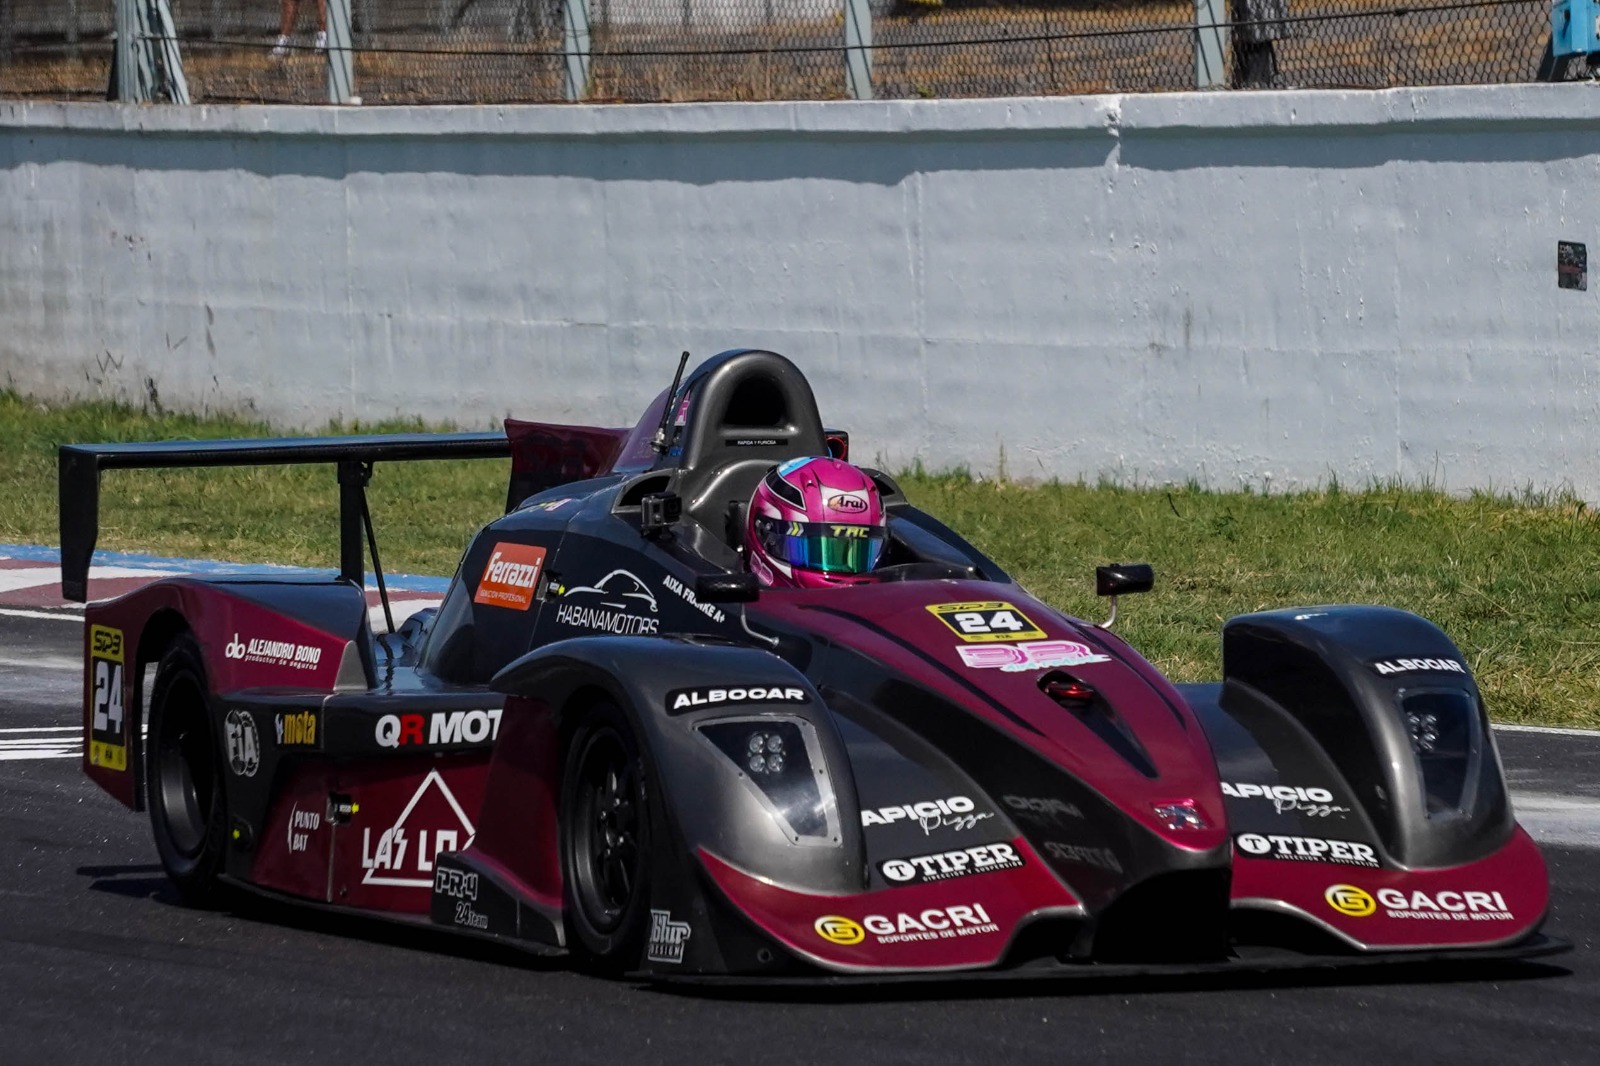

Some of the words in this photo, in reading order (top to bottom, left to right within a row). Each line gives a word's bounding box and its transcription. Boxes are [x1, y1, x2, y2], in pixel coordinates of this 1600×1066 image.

[837, 495, 864, 509] Arai
[484, 551, 542, 588] Ferrazzi
[662, 574, 684, 596] AIXA
[555, 603, 660, 634] HABANAMOTORS
[954, 610, 1023, 633] 24
[244, 654, 276, 665] productor
[278, 658, 288, 666] de
[246, 638, 296, 660] ALEJANDRO
[294, 645, 322, 664] BONO
[1374, 658, 1467, 675] ALBOCAR
[93, 660, 123, 734] 24
[673, 688, 805, 710] ALBOCAR
[283, 710, 317, 745] mota
[375, 713, 426, 750] QR
[1220, 782, 1334, 803] APICIO
[860, 796, 975, 827] APICIO
[910, 842, 1020, 877] TIPER
[1267, 834, 1379, 864] TIPER
[1377, 888, 1508, 912] GACRI
[863, 902, 992, 936] GACRI
[1386, 909, 1451, 921] SOPORTES
[1452, 913, 1469, 921] DE
[1470, 912, 1515, 921] MOTOR
[652, 914, 688, 945] blur
[876, 931, 939, 945] SOPORTES
[941, 929, 956, 938] DE
[957, 923, 1000, 937] MOTOR
